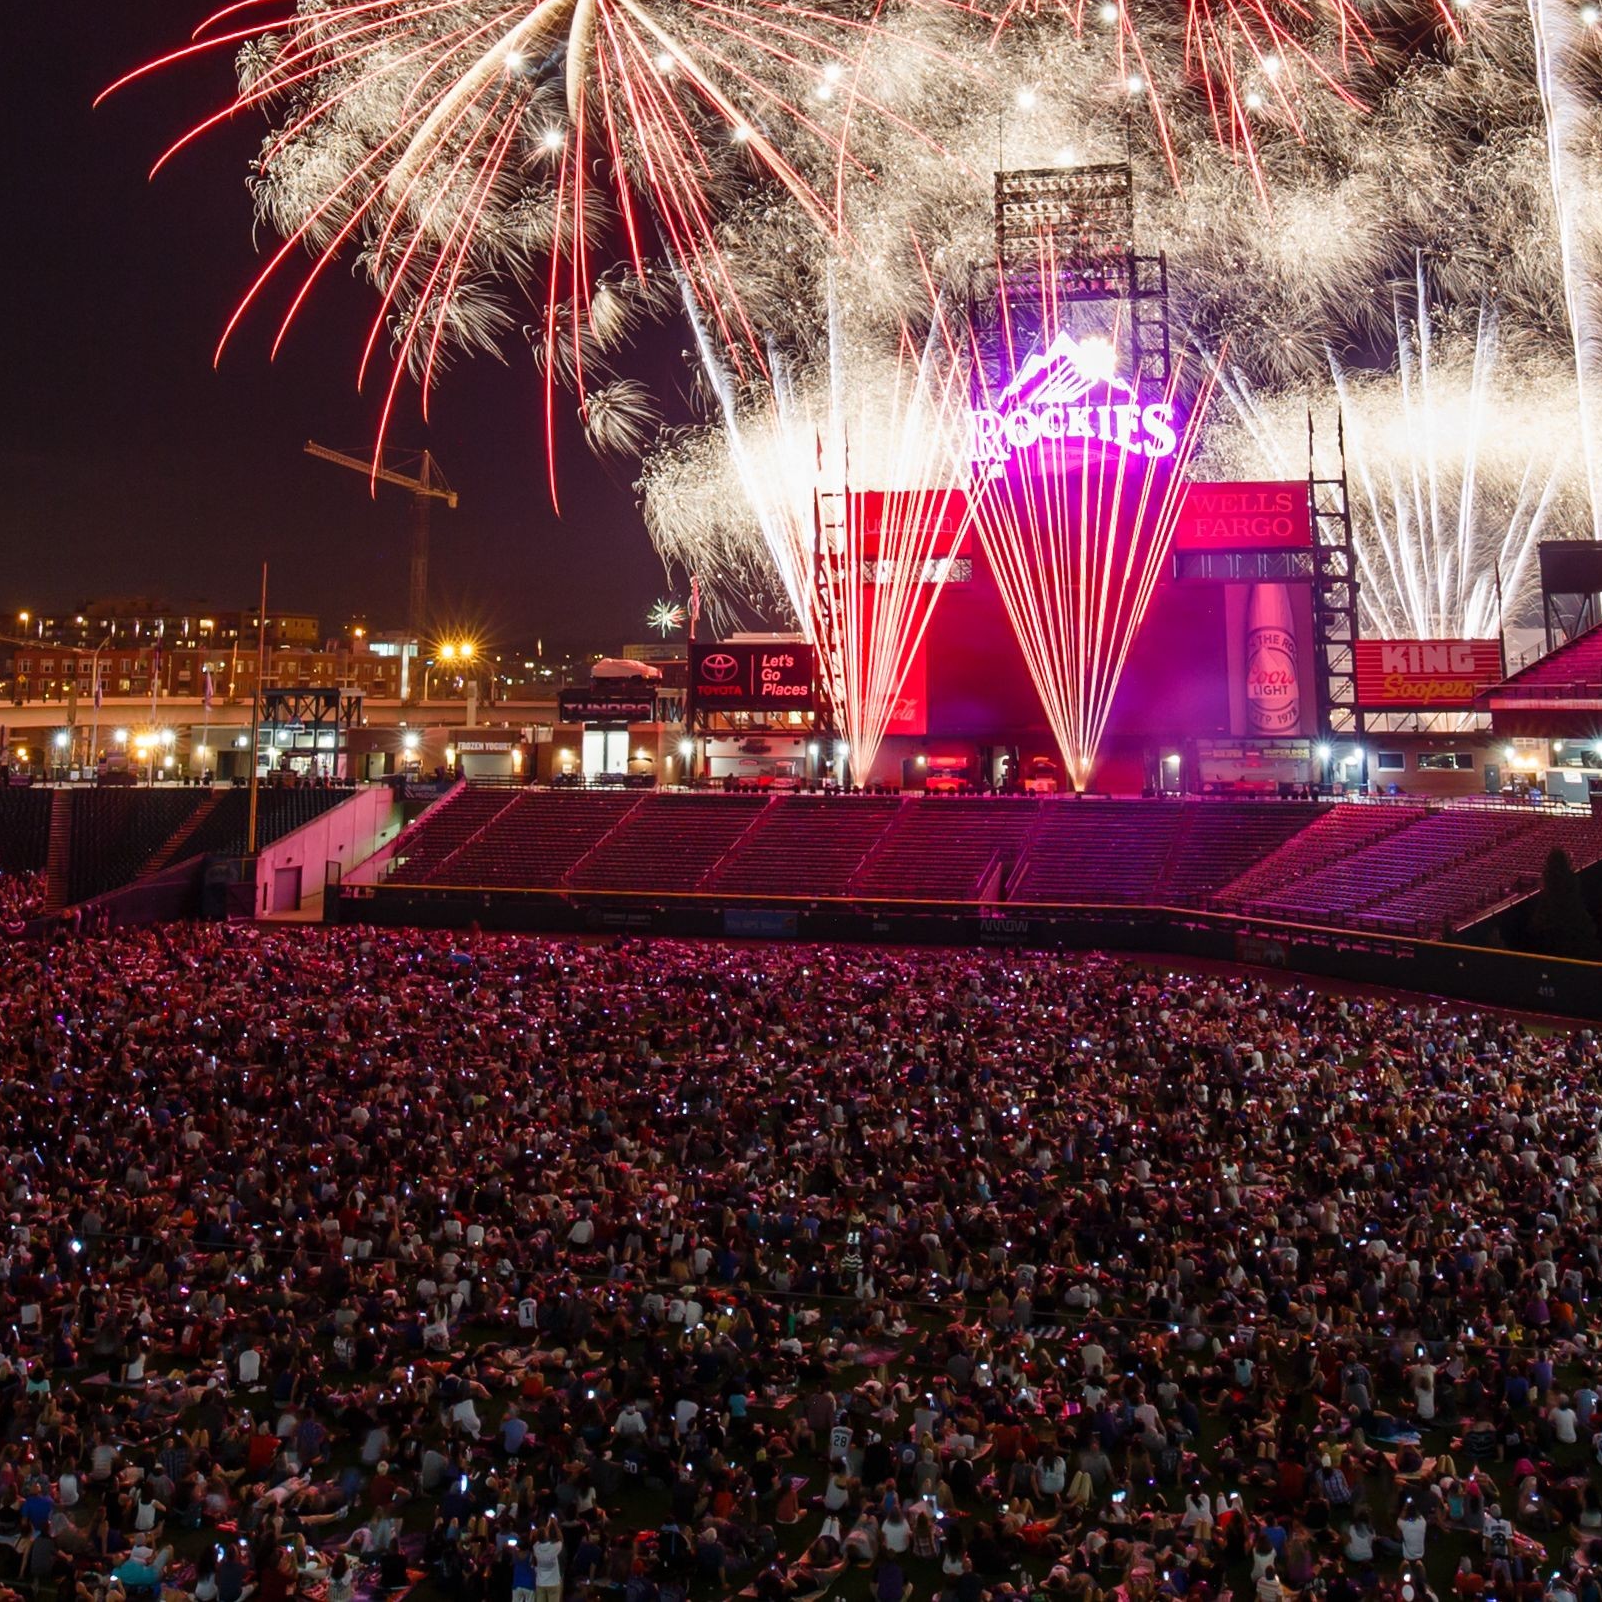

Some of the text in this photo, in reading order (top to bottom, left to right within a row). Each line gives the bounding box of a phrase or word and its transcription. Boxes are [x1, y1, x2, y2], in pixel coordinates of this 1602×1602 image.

[965, 402, 1177, 462] ROCKIES
[1190, 492, 1293, 513] WELLS
[1194, 516, 1293, 537] FARGO
[761, 653, 795, 668] Let's
[1381, 646, 1476, 674] KING
[761, 668, 782, 681] Go
[698, 684, 743, 696] TOYOTA
[761, 683, 809, 696] Places
[1253, 685, 1289, 696] LIGHT
[458, 741, 513, 750] FROZEN YOGURT
